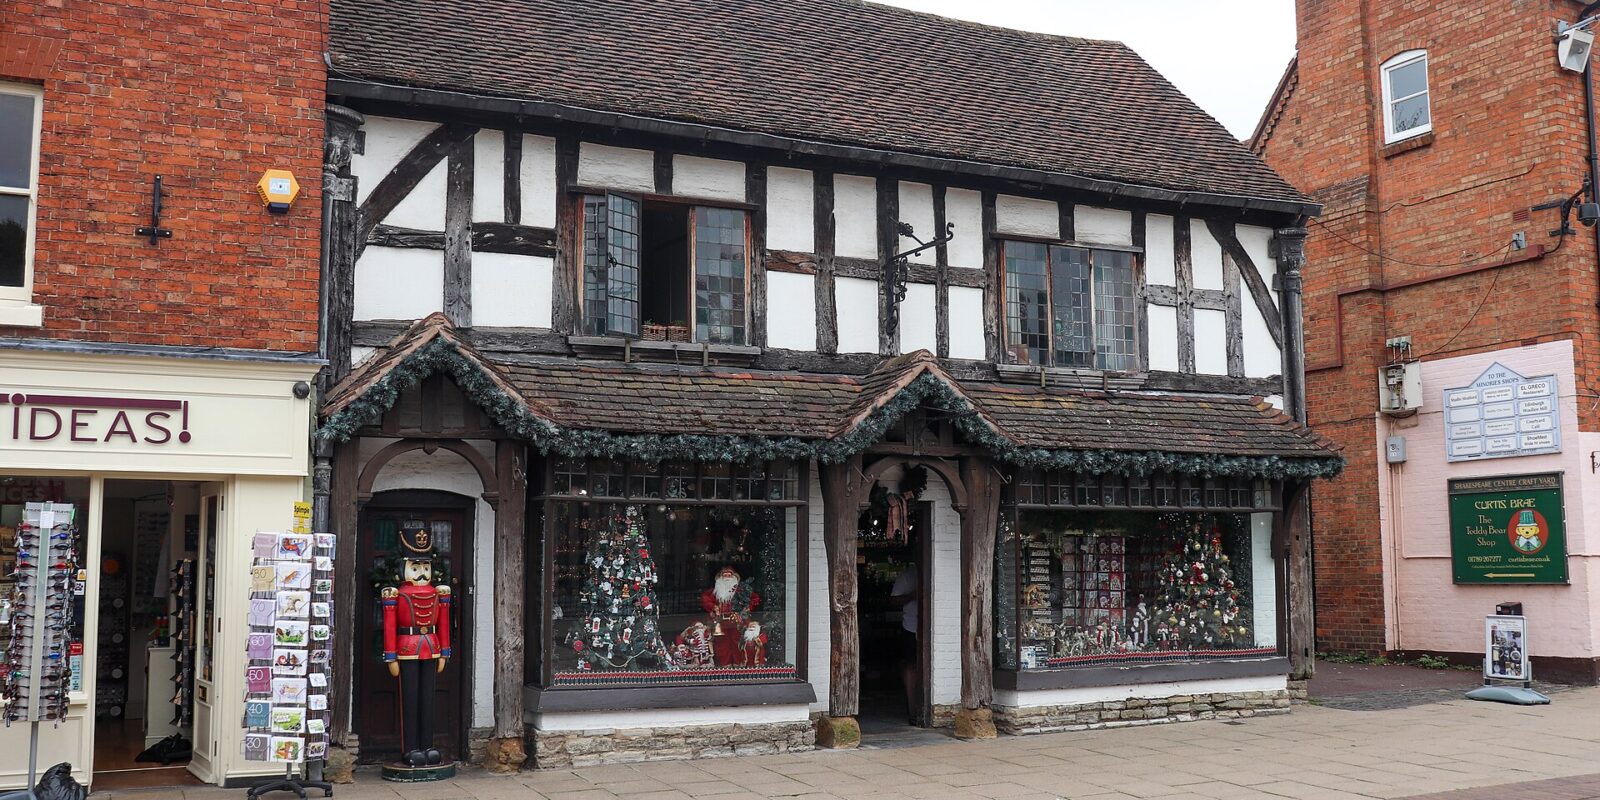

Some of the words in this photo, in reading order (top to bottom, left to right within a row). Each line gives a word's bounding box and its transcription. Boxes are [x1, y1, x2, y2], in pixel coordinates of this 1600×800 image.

[1476, 380, 1501, 388] MINORIES
[1454, 481, 1492, 489] SHAKESPEARE
[1518, 478, 1538, 486] CRAFT
[1538, 476, 1556, 485] YARD
[1474, 499, 1507, 510] CURTIS
[1510, 498, 1536, 508] BRAE
[1478, 514, 1492, 524] The
[1465, 526, 1488, 536] Teddy
[1488, 525, 1506, 535] Bear
[1477, 537, 1496, 548] Shop
[253, 569, 267, 579] 80
[252, 601, 265, 612] 70
[250, 635, 265, 646] 60
[248, 669, 264, 681] 50
[248, 703, 263, 714] 40
[246, 737, 261, 748] 30
